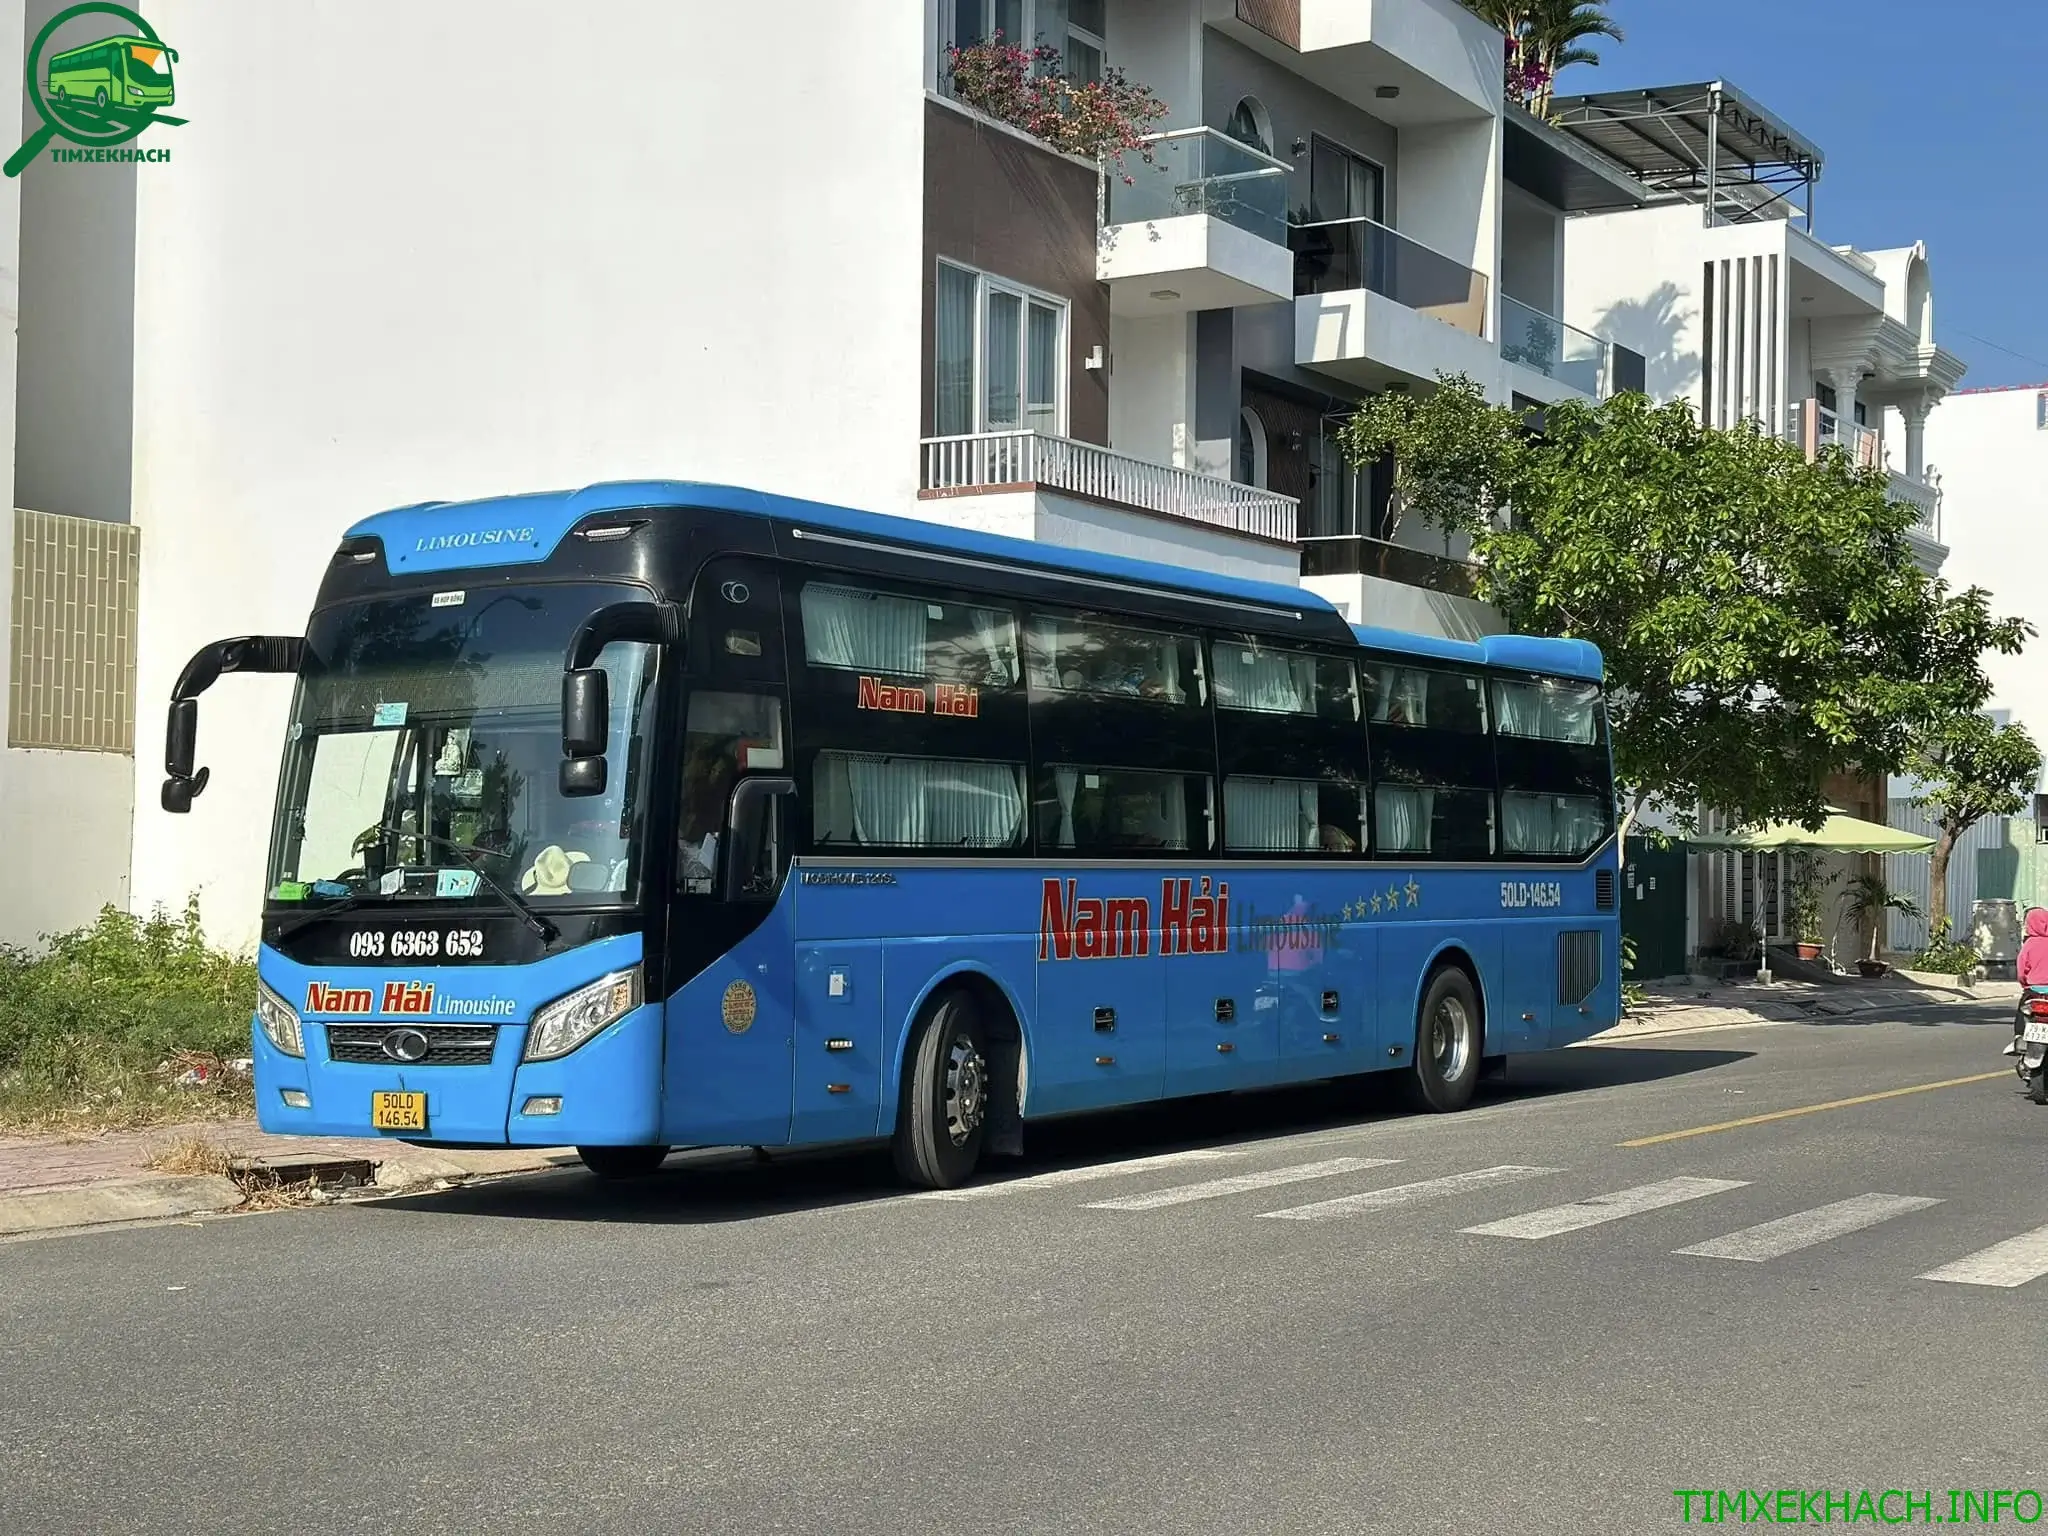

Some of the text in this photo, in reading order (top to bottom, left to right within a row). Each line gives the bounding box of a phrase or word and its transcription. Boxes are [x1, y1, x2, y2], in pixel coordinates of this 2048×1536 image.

[415, 527, 535, 552] LIMOUSINE
[857, 675, 979, 719] Nam Hải
[1500, 881, 1561, 908] 50LD-146.54
[1038, 875, 1343, 961] Nam Hải Limousine
[349, 929, 484, 958] 093 6363 652
[303, 979, 516, 1016] Nam Hải Limousine
[383, 1093, 414, 1111] 50LD
[378, 1111, 419, 1128] 146.54
